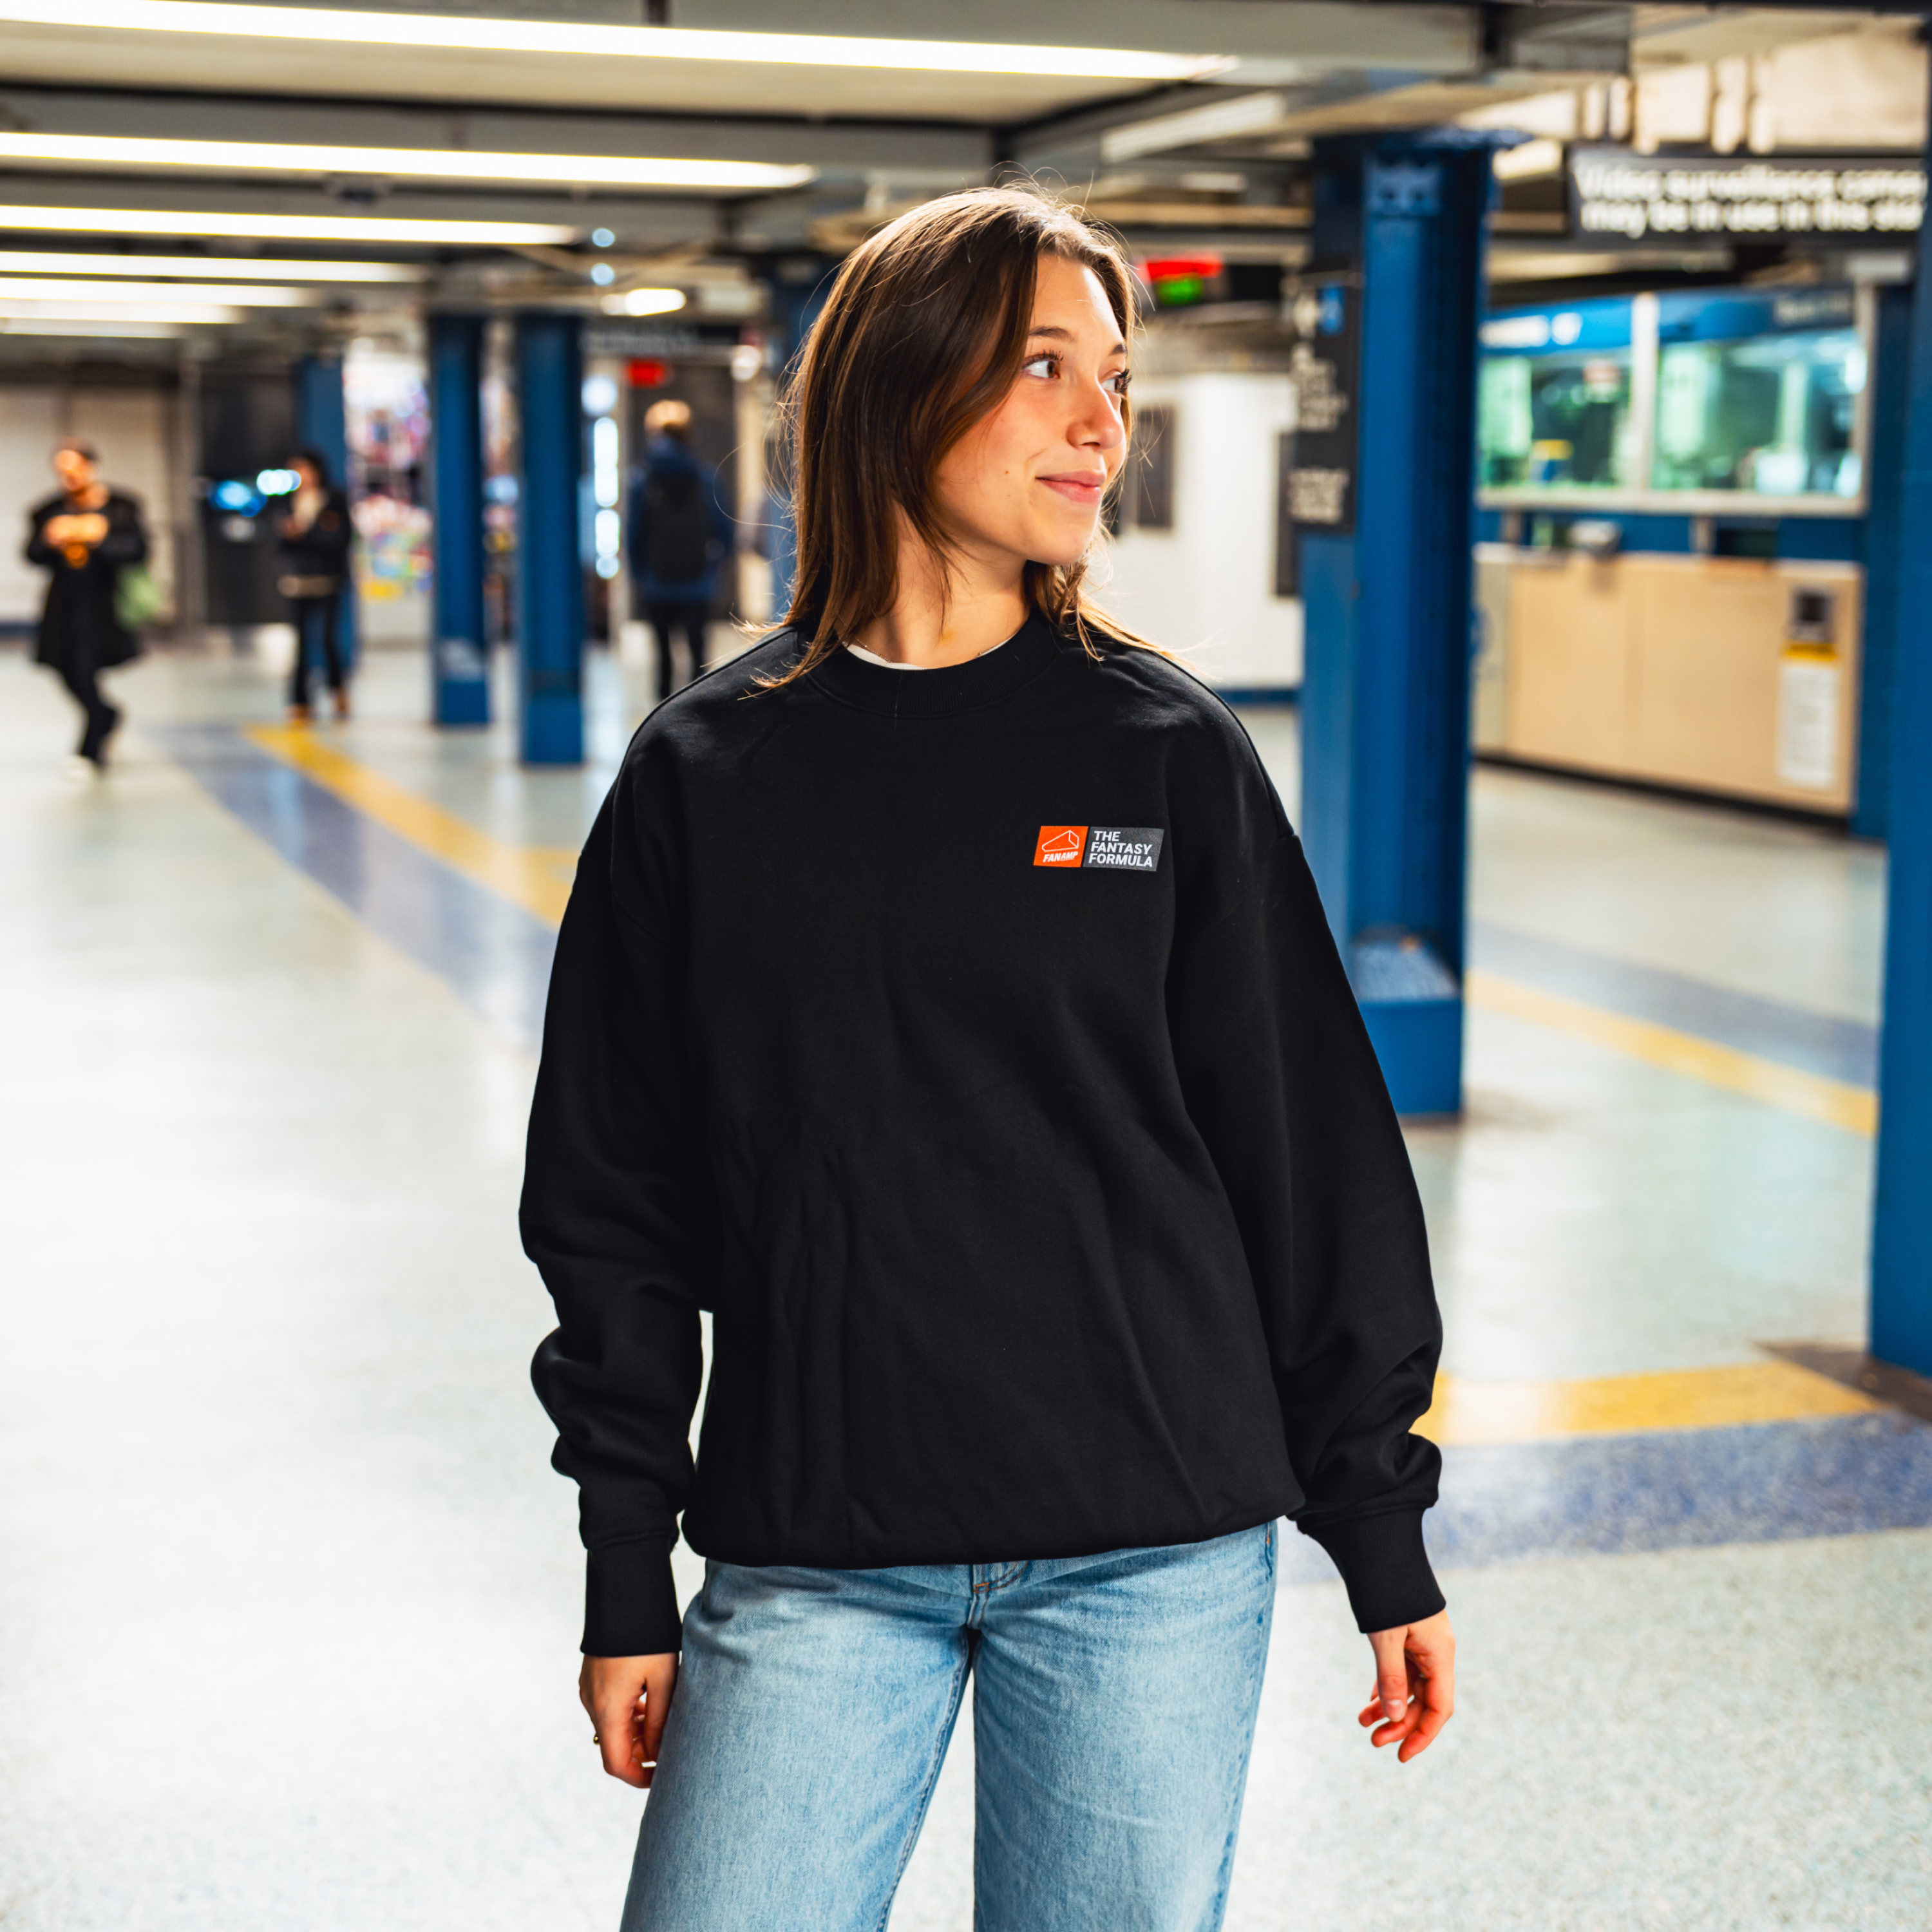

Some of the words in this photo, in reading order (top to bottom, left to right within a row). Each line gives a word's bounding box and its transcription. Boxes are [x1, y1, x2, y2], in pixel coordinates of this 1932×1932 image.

[1094, 831, 1121, 841] THE
[1091, 842, 1152, 855] FANTASY
[1043, 851, 1078, 862] FANAMP
[1088, 853, 1153, 867] FORMULA
